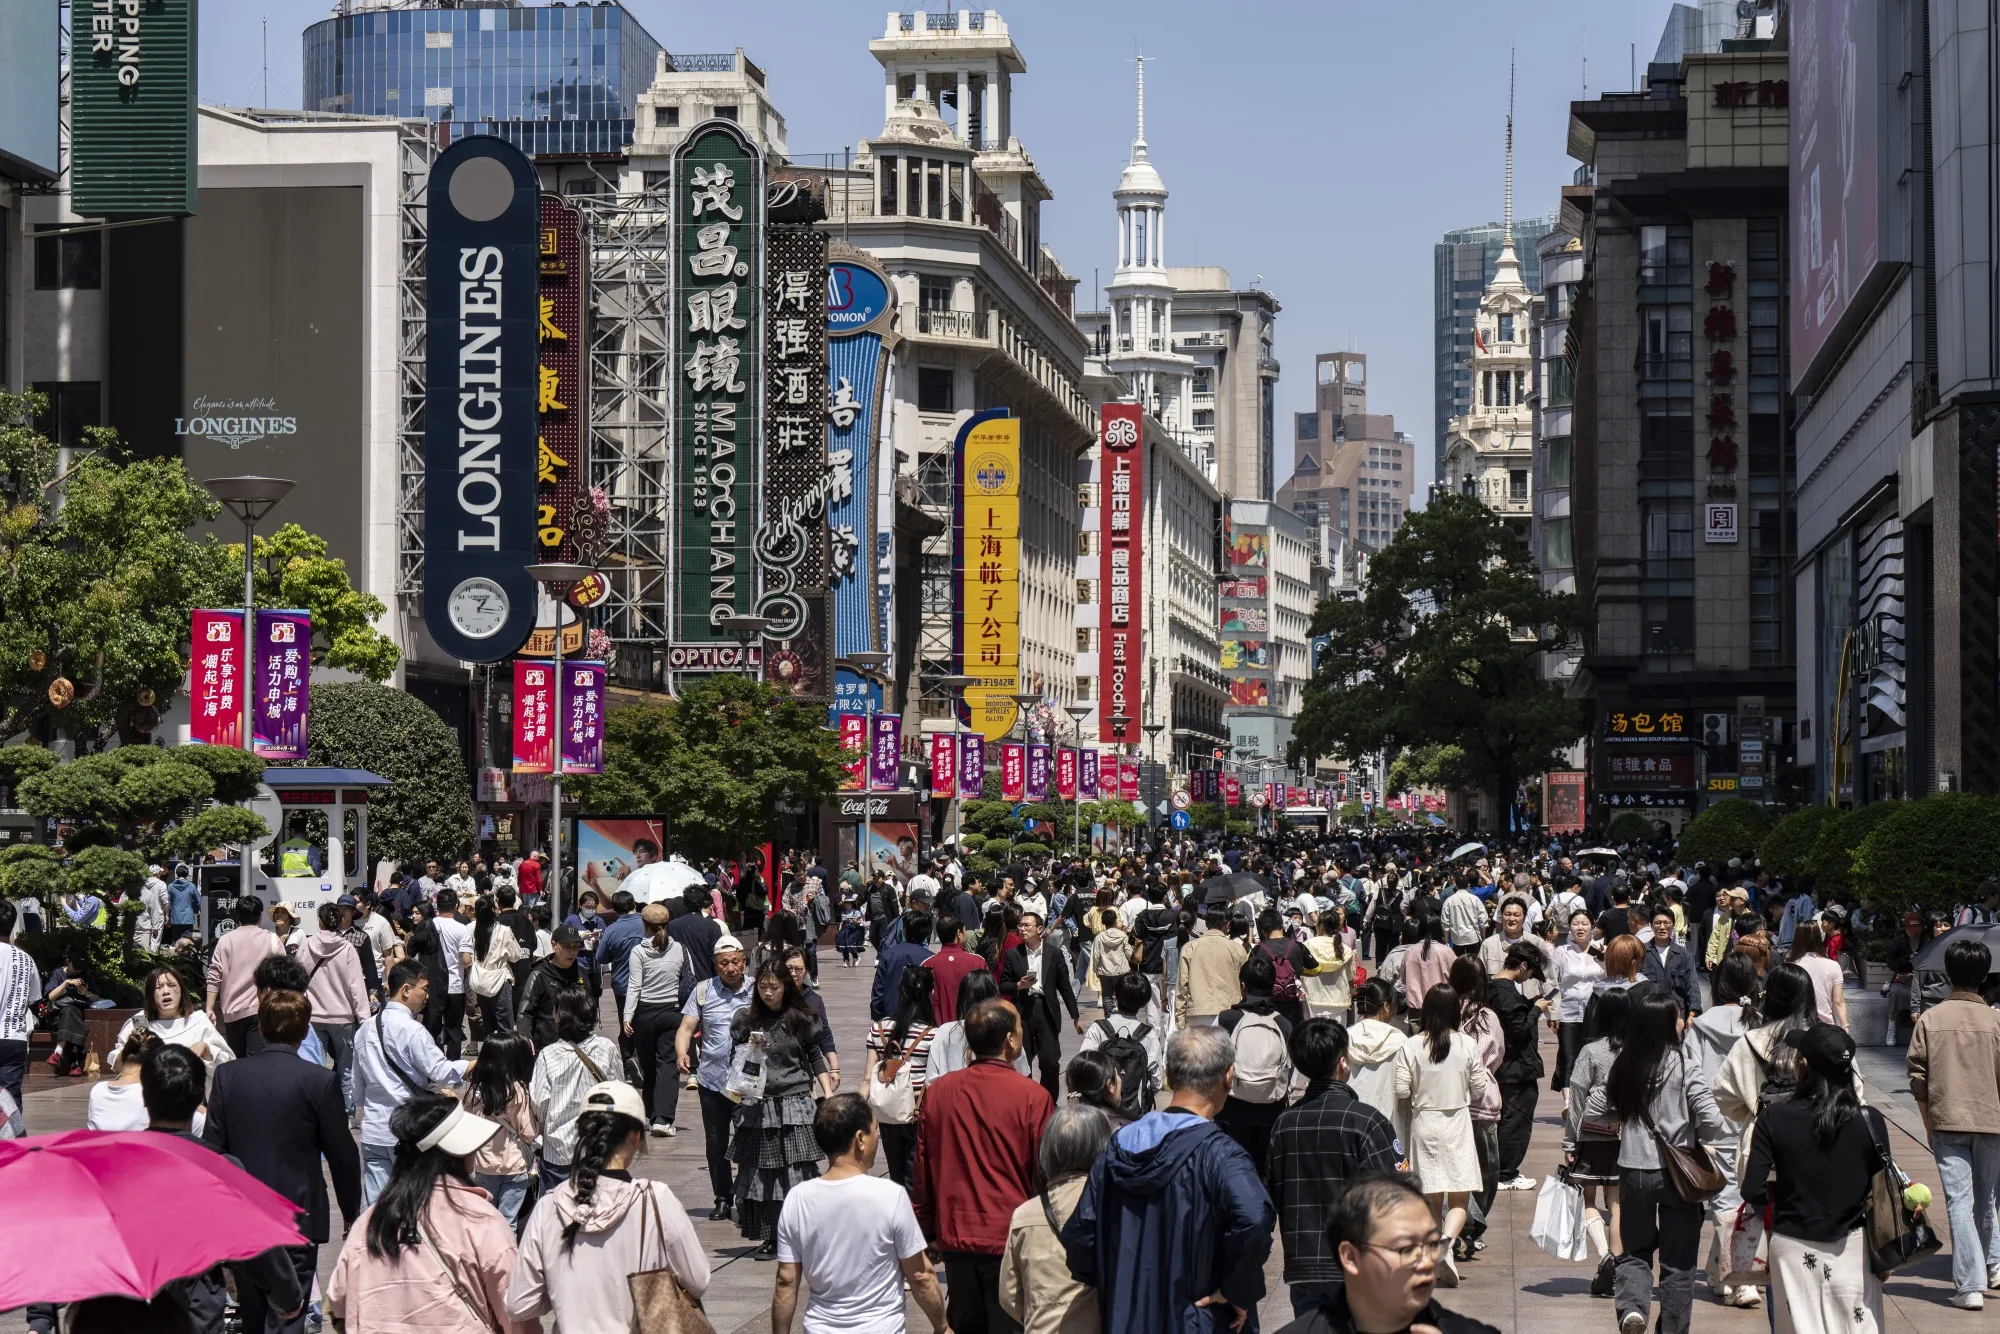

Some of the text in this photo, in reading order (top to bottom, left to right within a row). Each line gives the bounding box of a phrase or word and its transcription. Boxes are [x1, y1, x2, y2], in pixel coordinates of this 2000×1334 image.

[92, 0, 113, 52] TER
[119, 0, 140, 86] PPING
[685, 163, 743, 393] 茂昌眼镜
[828, 313, 866, 322] OMON
[193, 395, 226, 418] Elegance
[458, 246, 503, 551] LONGINES
[1343, 387, 1366, 396] EDITION
[175, 416, 297, 435] LONGINES
[693, 402, 708, 508] SINCE 1923
[1111, 456, 1130, 622] 上海市第一食品商店
[980, 508, 1003, 667] 上海帐子公司
[220, 648, 234, 709] 乐享消费
[284, 649, 300, 712] 爱购上海
[671, 648, 760, 665] OPTICAL
[203, 654, 219, 716] 潮起上海
[267, 655, 282, 719] 活力申城
[1113, 633, 1127, 731] First Foodh
[522, 694, 534, 742] 潮起上海
[536, 689, 548, 738] 乐享消费
[572, 695, 584, 744] 活力申城
[584, 690, 596, 738] 爱购上海
[1611, 711, 1684, 733] 汤包馆
[1235, 735, 1260, 747] 退税
[1611, 757, 1673, 772] 新雅食品
[1708, 779, 1740, 791] SUB
[216, 897, 239, 909] 黄浦
[7, 964, 18, 1009] GREYHOUND
